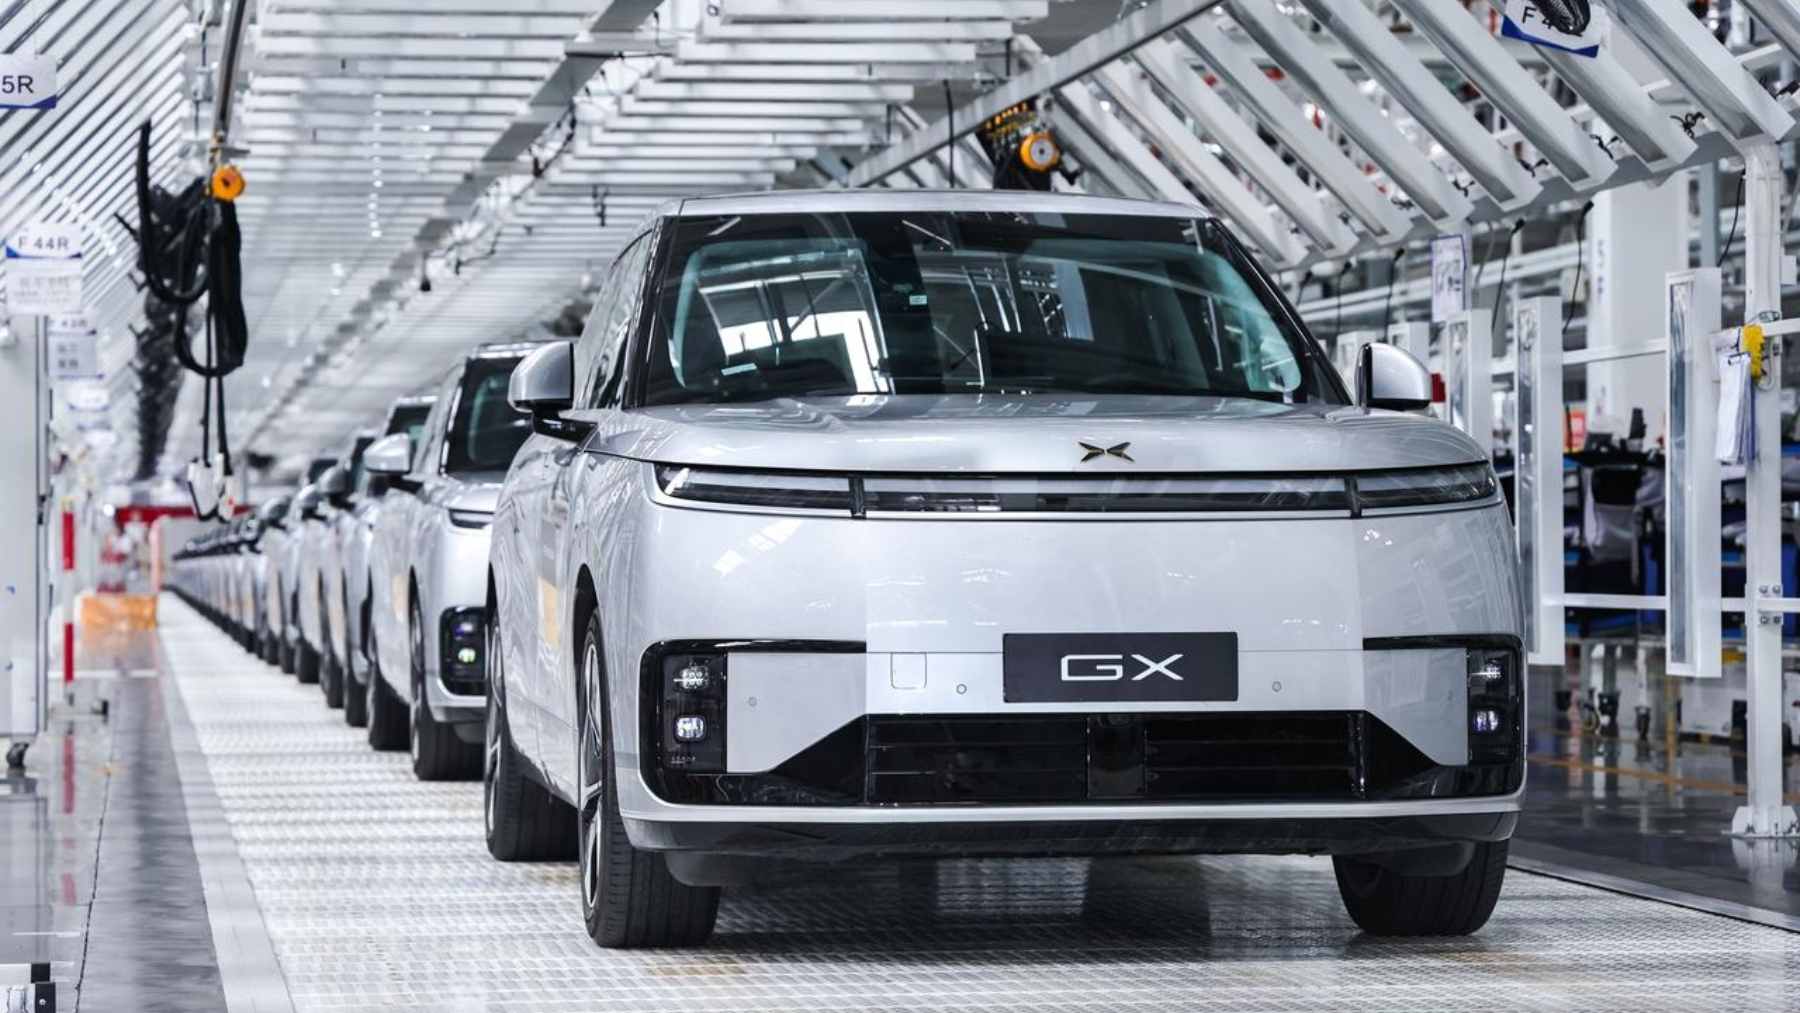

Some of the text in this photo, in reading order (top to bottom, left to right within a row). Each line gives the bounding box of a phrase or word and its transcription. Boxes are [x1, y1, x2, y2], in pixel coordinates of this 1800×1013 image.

[1522, 6, 1537, 24] F
[18, 236, 69, 250] F 44R
[1060, 653, 1184, 681] GX
